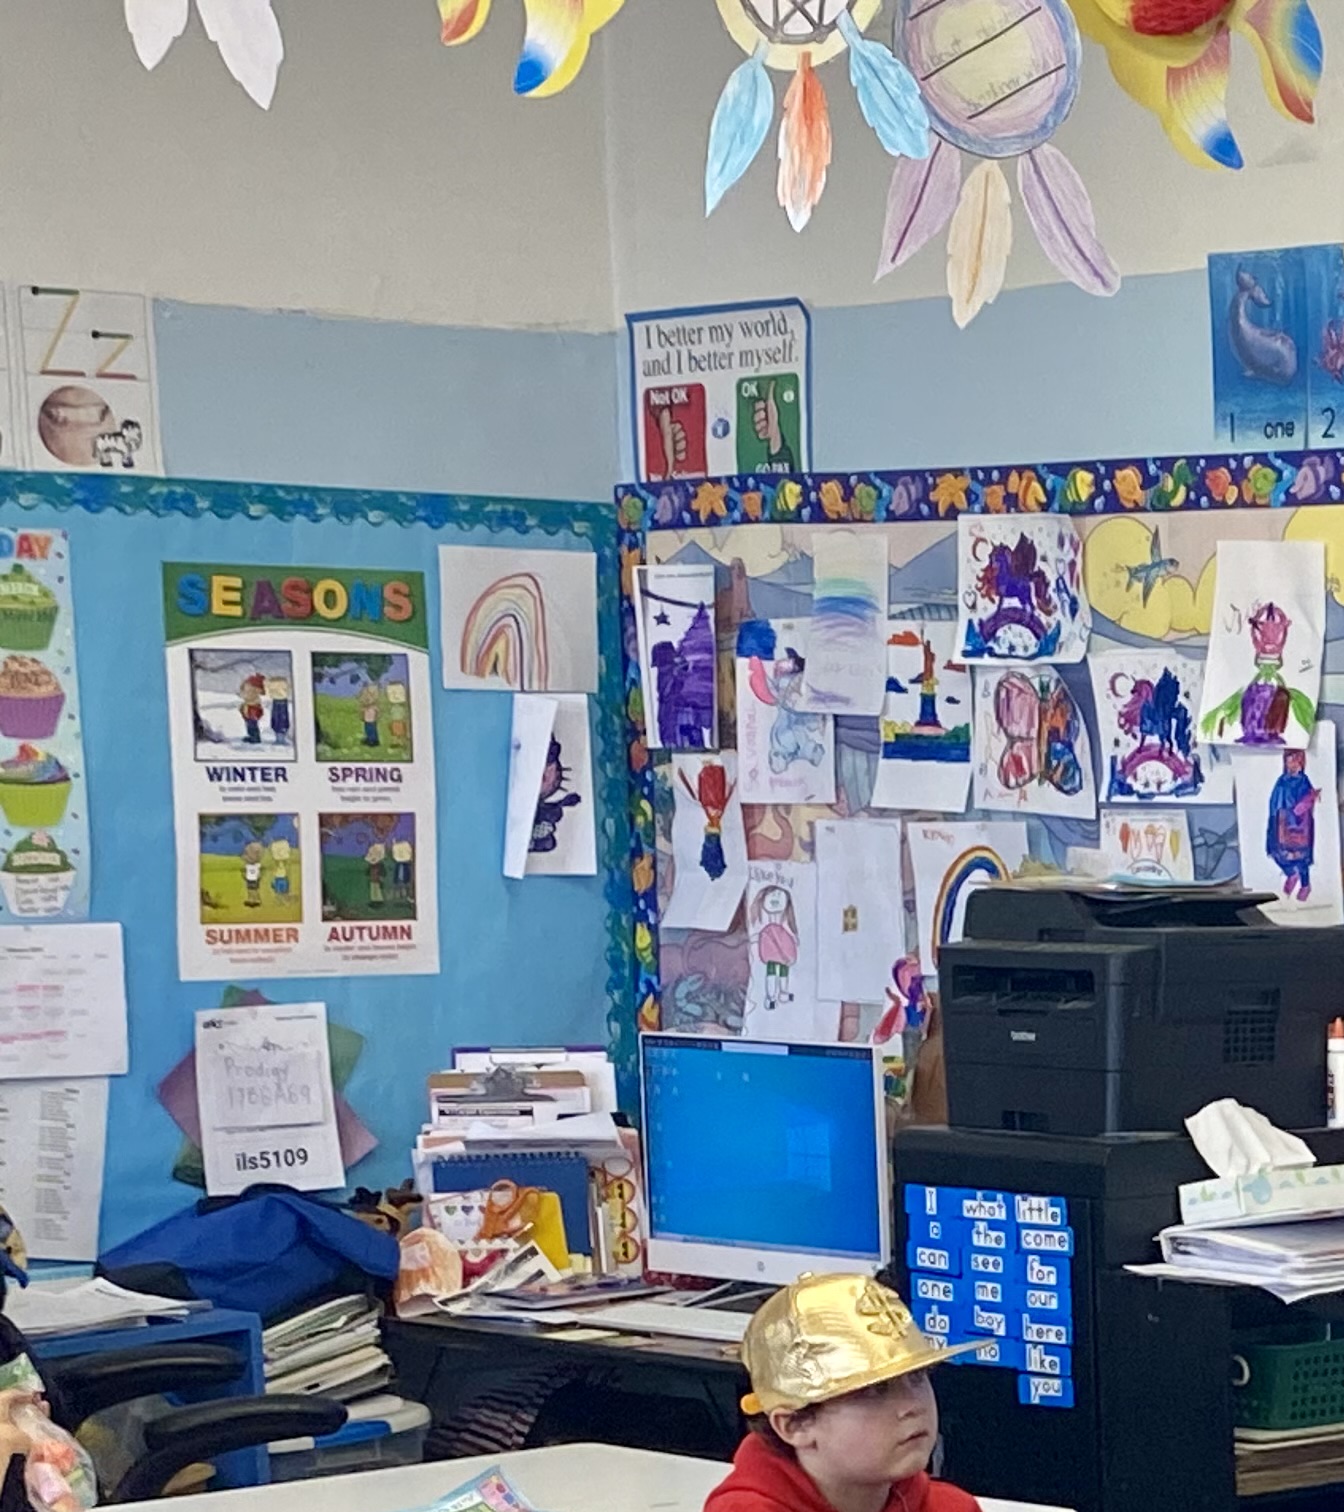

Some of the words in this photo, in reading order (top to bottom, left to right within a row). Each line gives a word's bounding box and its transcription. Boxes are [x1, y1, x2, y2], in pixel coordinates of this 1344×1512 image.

[657, 323, 704, 348] better
[709, 321, 734, 348] my
[739, 310, 796, 341] world,
[642, 353, 672, 377] and
[687, 348, 734, 374] better
[739, 338, 799, 373] myself.
[671, 387, 690, 403] OK
[741, 381, 758, 398] OK
[1229, 413, 1235, 443] 1
[1264, 419, 1295, 440] one
[1321, 407, 1336, 439] 2
[177, 572, 413, 621] SEASONS
[205, 766, 288, 783] WINTER
[328, 766, 403, 783] SPRING
[205, 927, 299, 945] SUMMER
[327, 925, 413, 943] AUTUMN
[224, 1057, 289, 1080] Prodigy
[235, 1147, 309, 1171] ils5109
[965, 1193, 1006, 1218] what
[1017, 1197, 1061, 1223] little
[974, 1226, 1003, 1247] the
[1023, 1231, 1068, 1249] come
[918, 1251, 948, 1268] can
[972, 1256, 1001, 1271] see
[1029, 1258, 1055, 1283] for
[919, 1282, 952, 1298] one
[976, 1284, 1000, 1300] me
[1028, 1293, 1056, 1307] our
[928, 1308, 947, 1330] do
[975, 1308, 1004, 1332] boy
[1025, 1318, 1064, 1341] here
[977, 1345, 998, 1359] no
[1027, 1346, 1058, 1371] like
[1032, 1381, 1062, 1401] you
